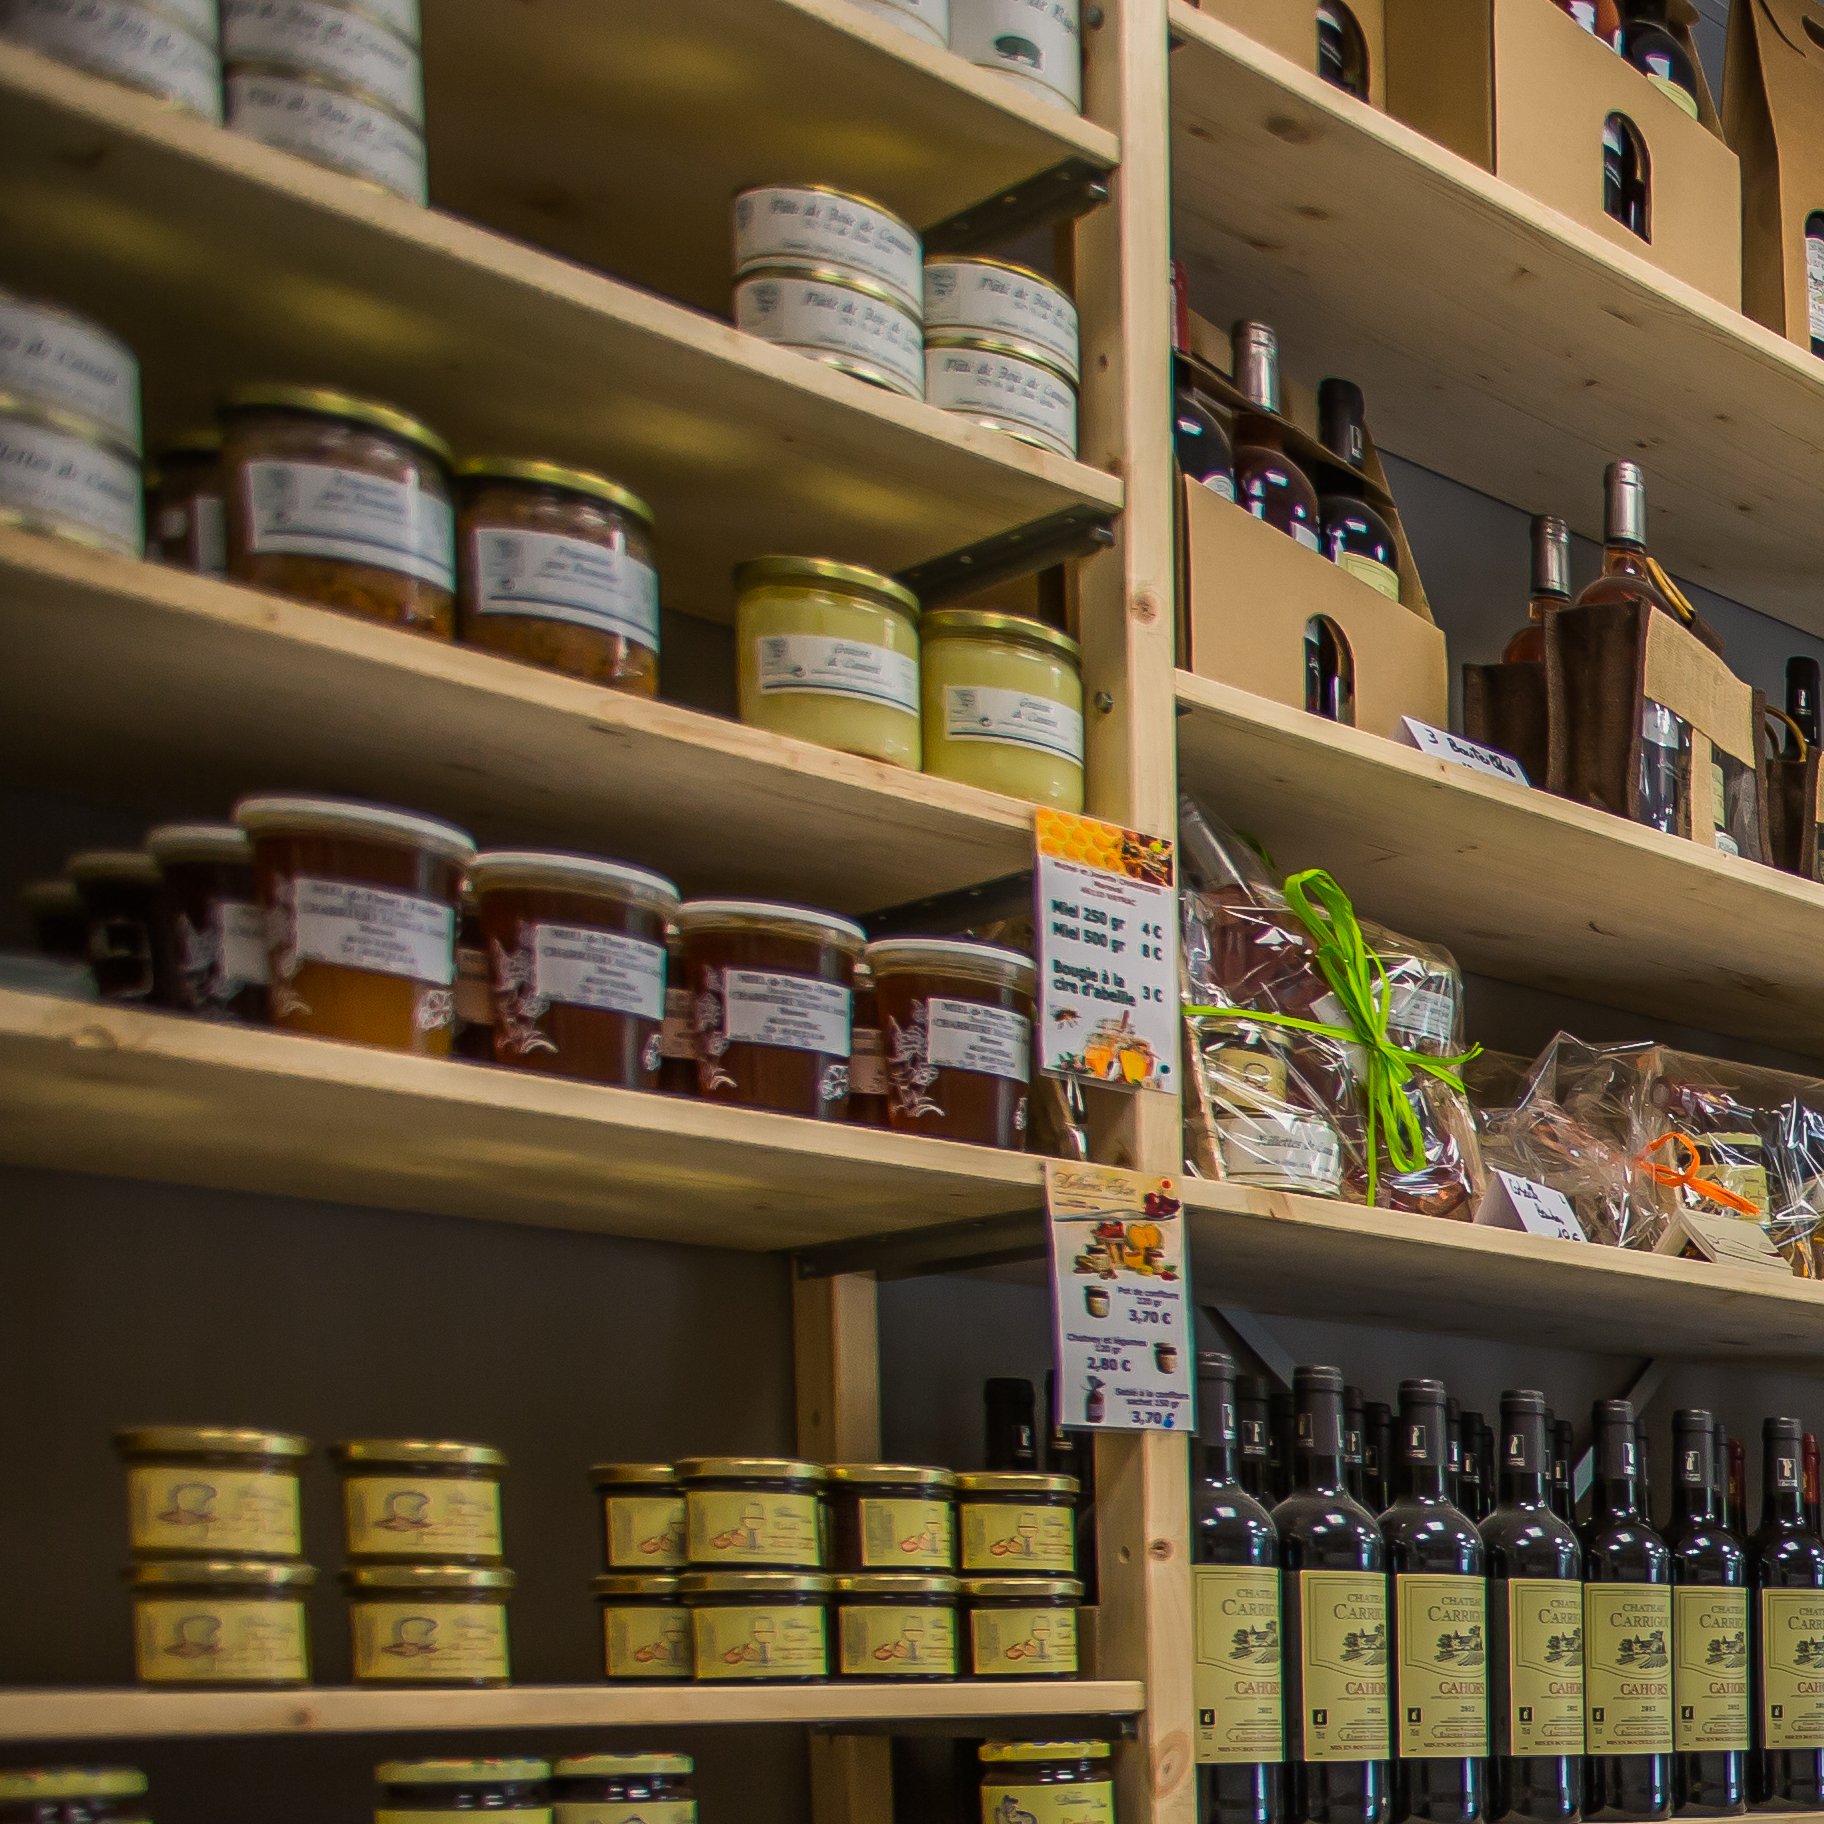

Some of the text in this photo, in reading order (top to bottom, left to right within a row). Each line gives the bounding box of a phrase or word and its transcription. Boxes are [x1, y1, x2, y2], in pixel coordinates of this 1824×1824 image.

[1424, 727, 1439, 744] 3
[1051, 899, 1080, 919] Miel
[1083, 906, 1108, 926] 250
[1110, 916, 1126, 932] gr
[1052, 921, 1080, 941] Miel
[1083, 928, 1108, 948] 500
[1111, 939, 1126, 954] gr
[1052, 958, 1125, 989] Bougie à la
[1053, 978, 1078, 994] cire
[1081, 982, 1136, 1008] d'abeille
[1142, 986, 1151, 1000] 3
[1129, 1309, 1171, 1324] 3,70 €
[1087, 1357, 1131, 1372] 2,80 €
[1131, 1410, 1162, 1425] 3,70
[1620, 1683, 1668, 1695] CAHORS
